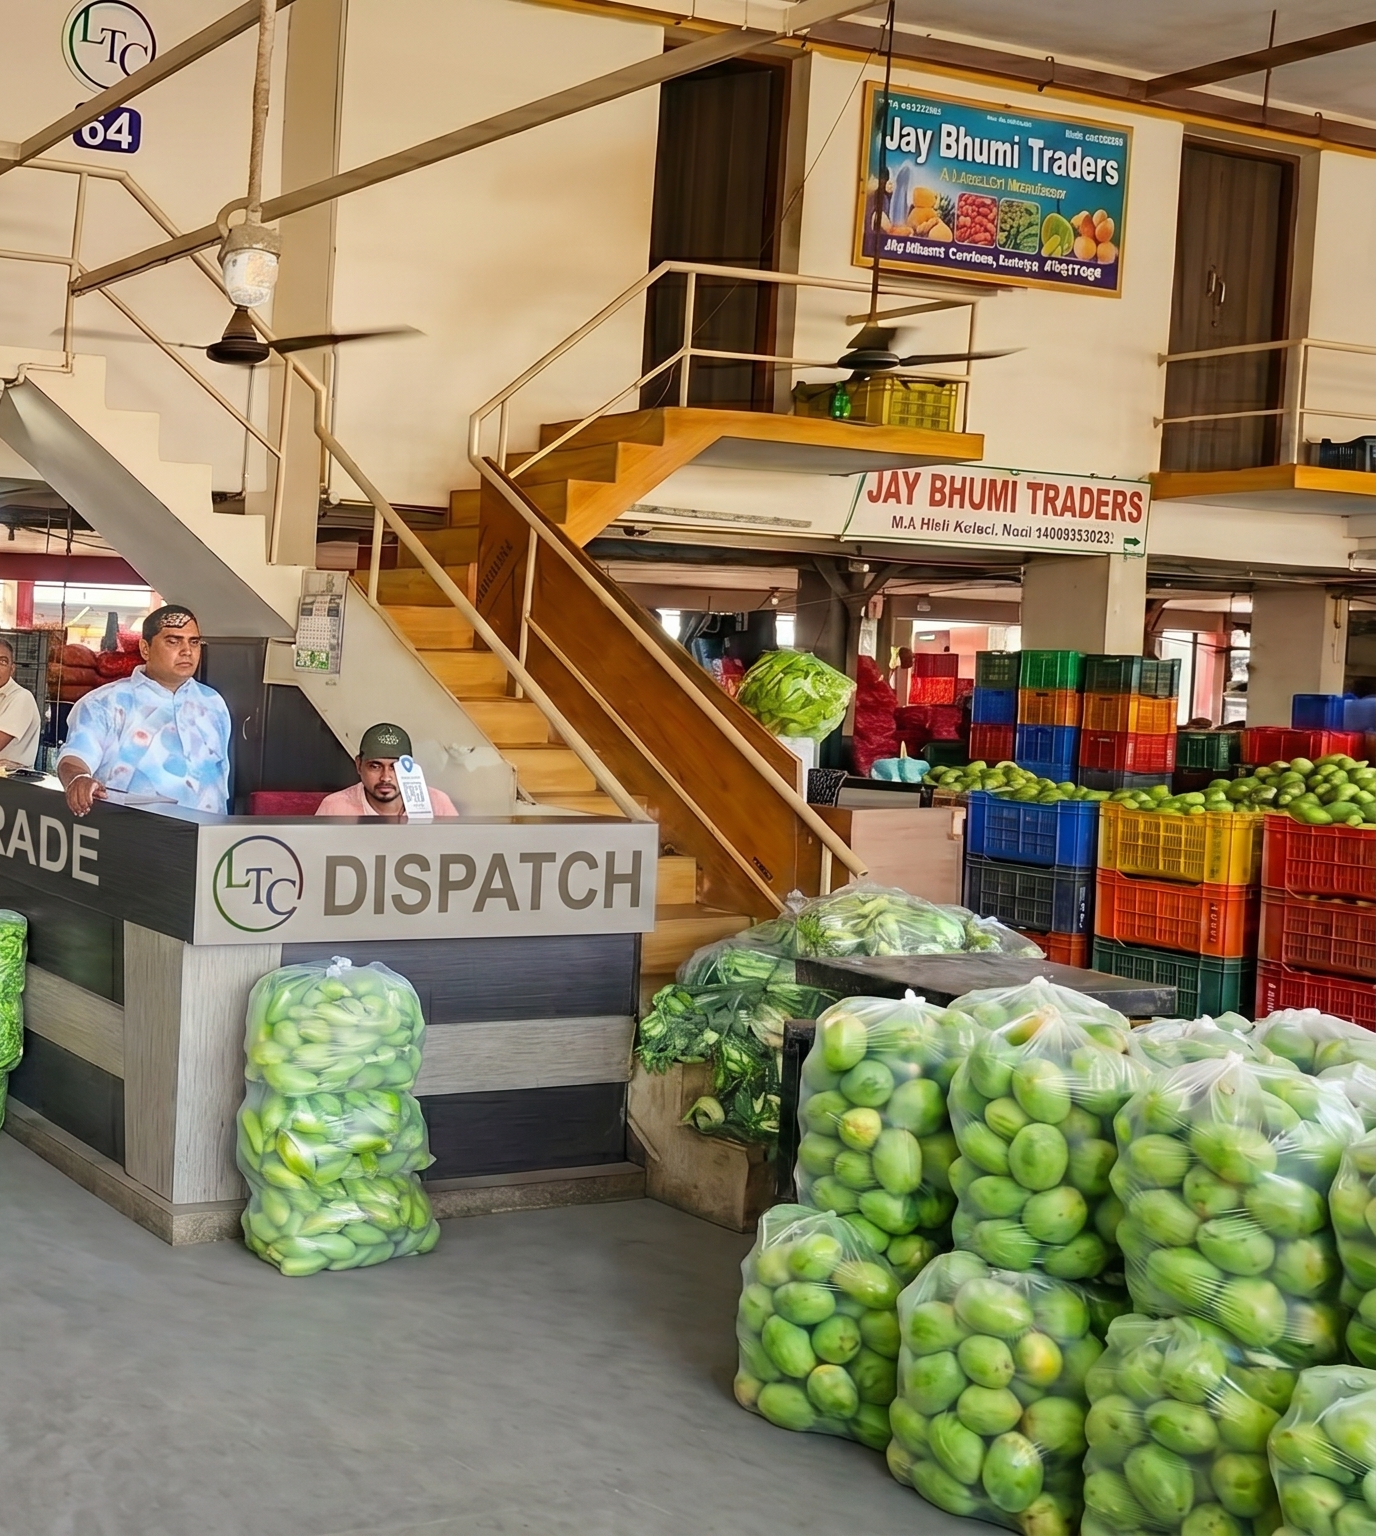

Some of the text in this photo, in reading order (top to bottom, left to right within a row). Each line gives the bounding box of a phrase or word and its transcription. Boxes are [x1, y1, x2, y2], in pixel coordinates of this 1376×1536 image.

[80, 7, 149, 77] LTC
[81, 112, 133, 150] 64
[885, 116, 933, 164] Jay
[939, 123, 1020, 169] Bhumi
[1028, 137, 1119, 186] Traders
[867, 470, 1143, 523] JAY BHUMI TRADERS
[225, 846, 643, 917] LTC DISPATCH
